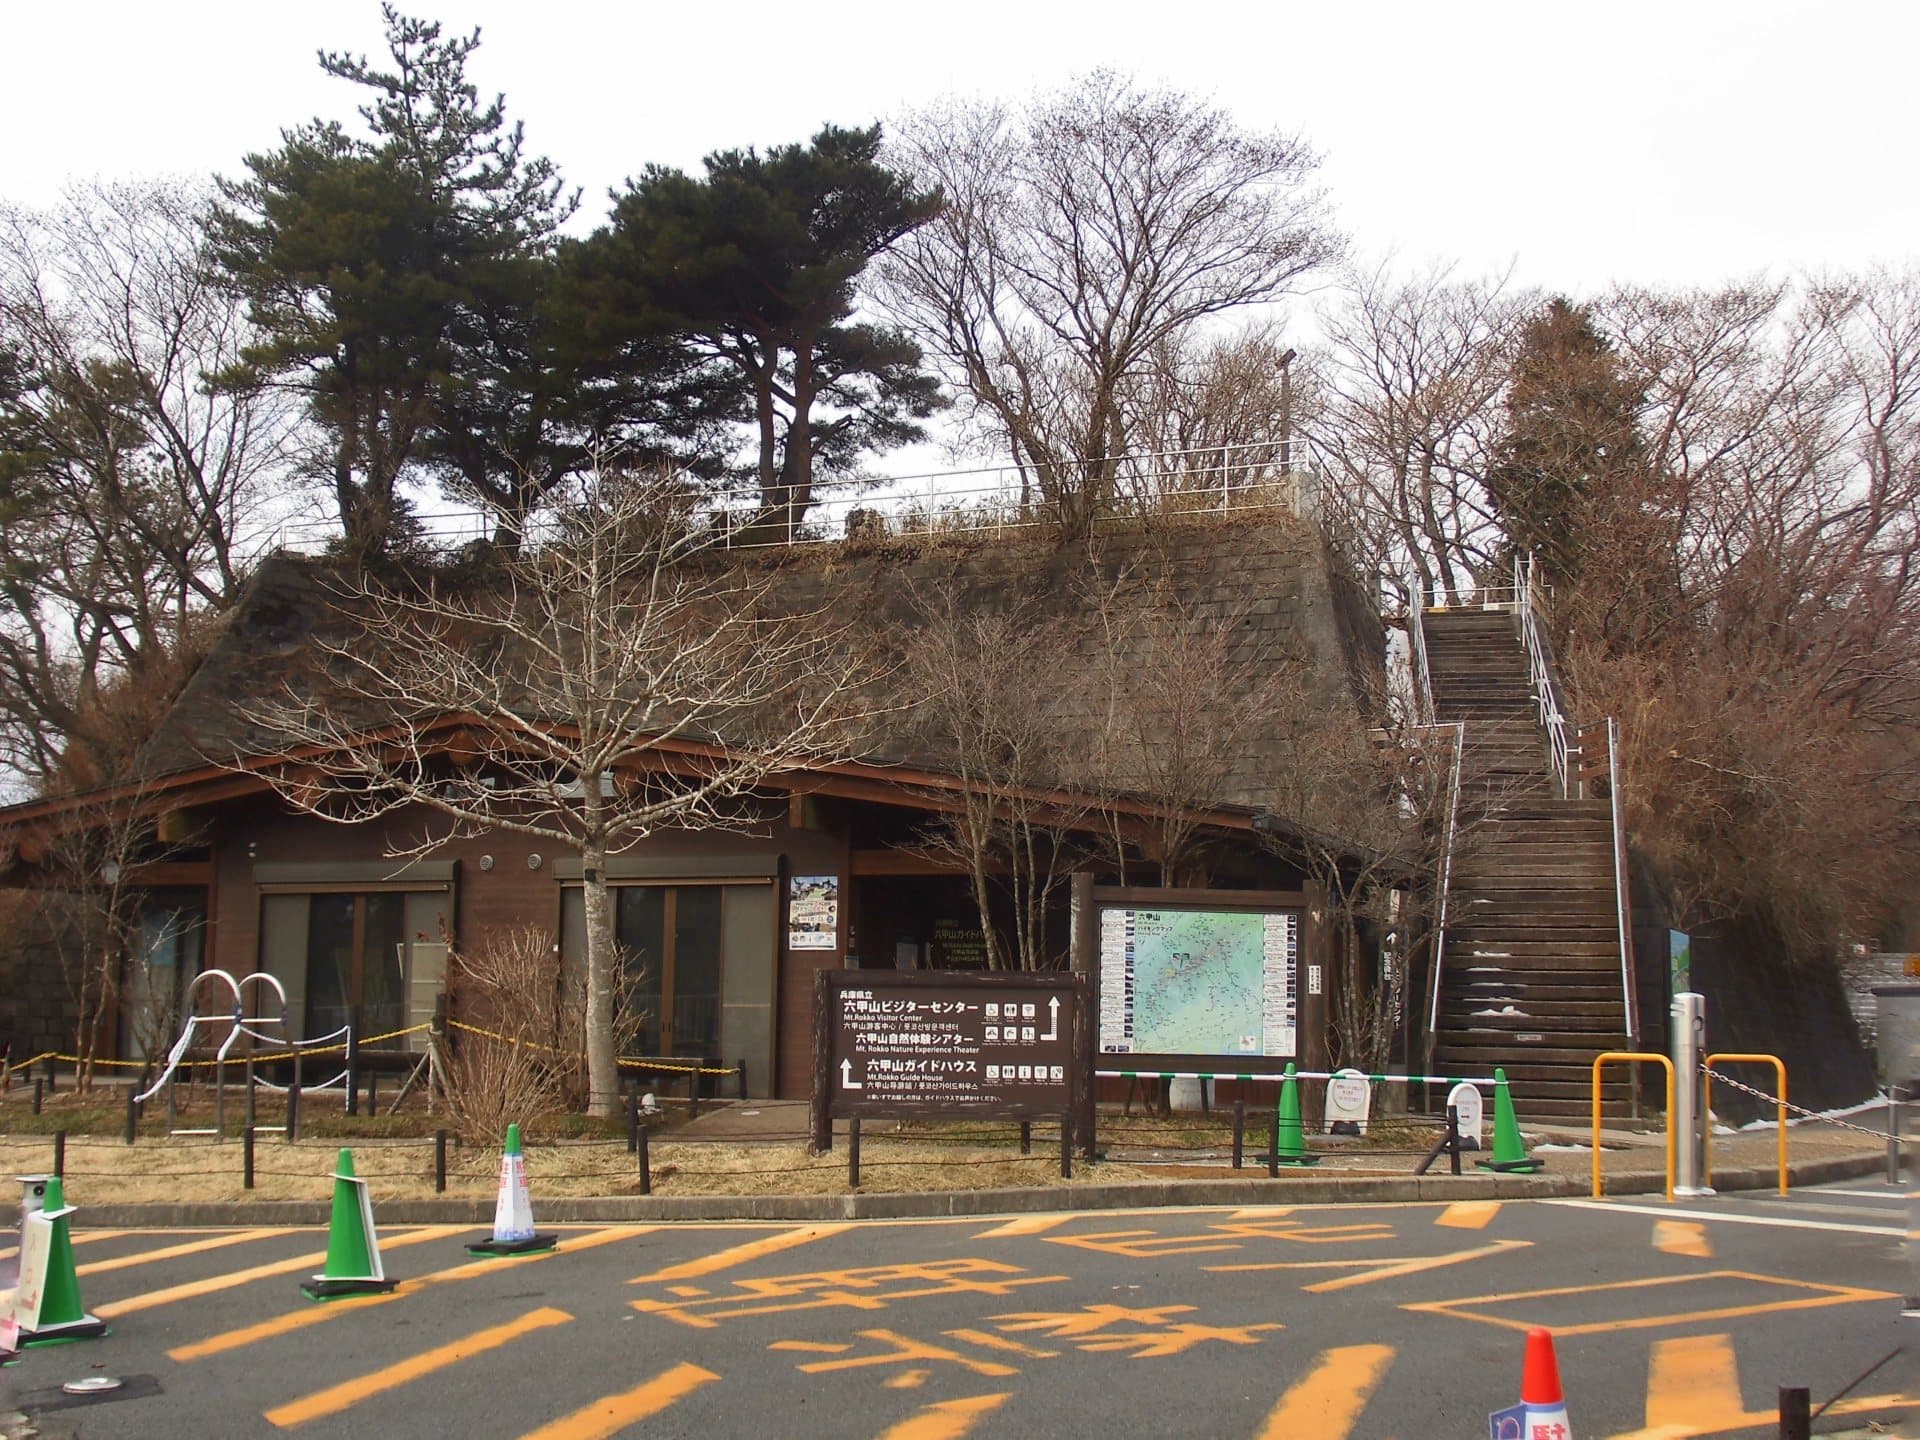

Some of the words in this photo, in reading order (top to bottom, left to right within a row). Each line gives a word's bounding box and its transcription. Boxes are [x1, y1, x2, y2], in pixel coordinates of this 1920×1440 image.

[1138, 913, 1160, 921] 六甲山
[840, 990, 873, 1000] 兵庫県立
[843, 1000, 979, 1014] 六甲山ビジターセンター
[876, 1014, 898, 1022] Visitor
[899, 1014, 922, 1022] Center
[855, 1032, 974, 1046] 六甲山自然体験シアター
[855, 1045, 867, 1053] Mt.
[867, 1045, 890, 1053] Rokko
[890, 1046, 914, 1054] Nature
[914, 1046, 952, 1056] Experience
[953, 1046, 980, 1054] Theater
[867, 1059, 977, 1072] 六甲山ガイドハウス
[900, 1073, 921, 1081] Guide
[921, 1074, 944, 1082] House
